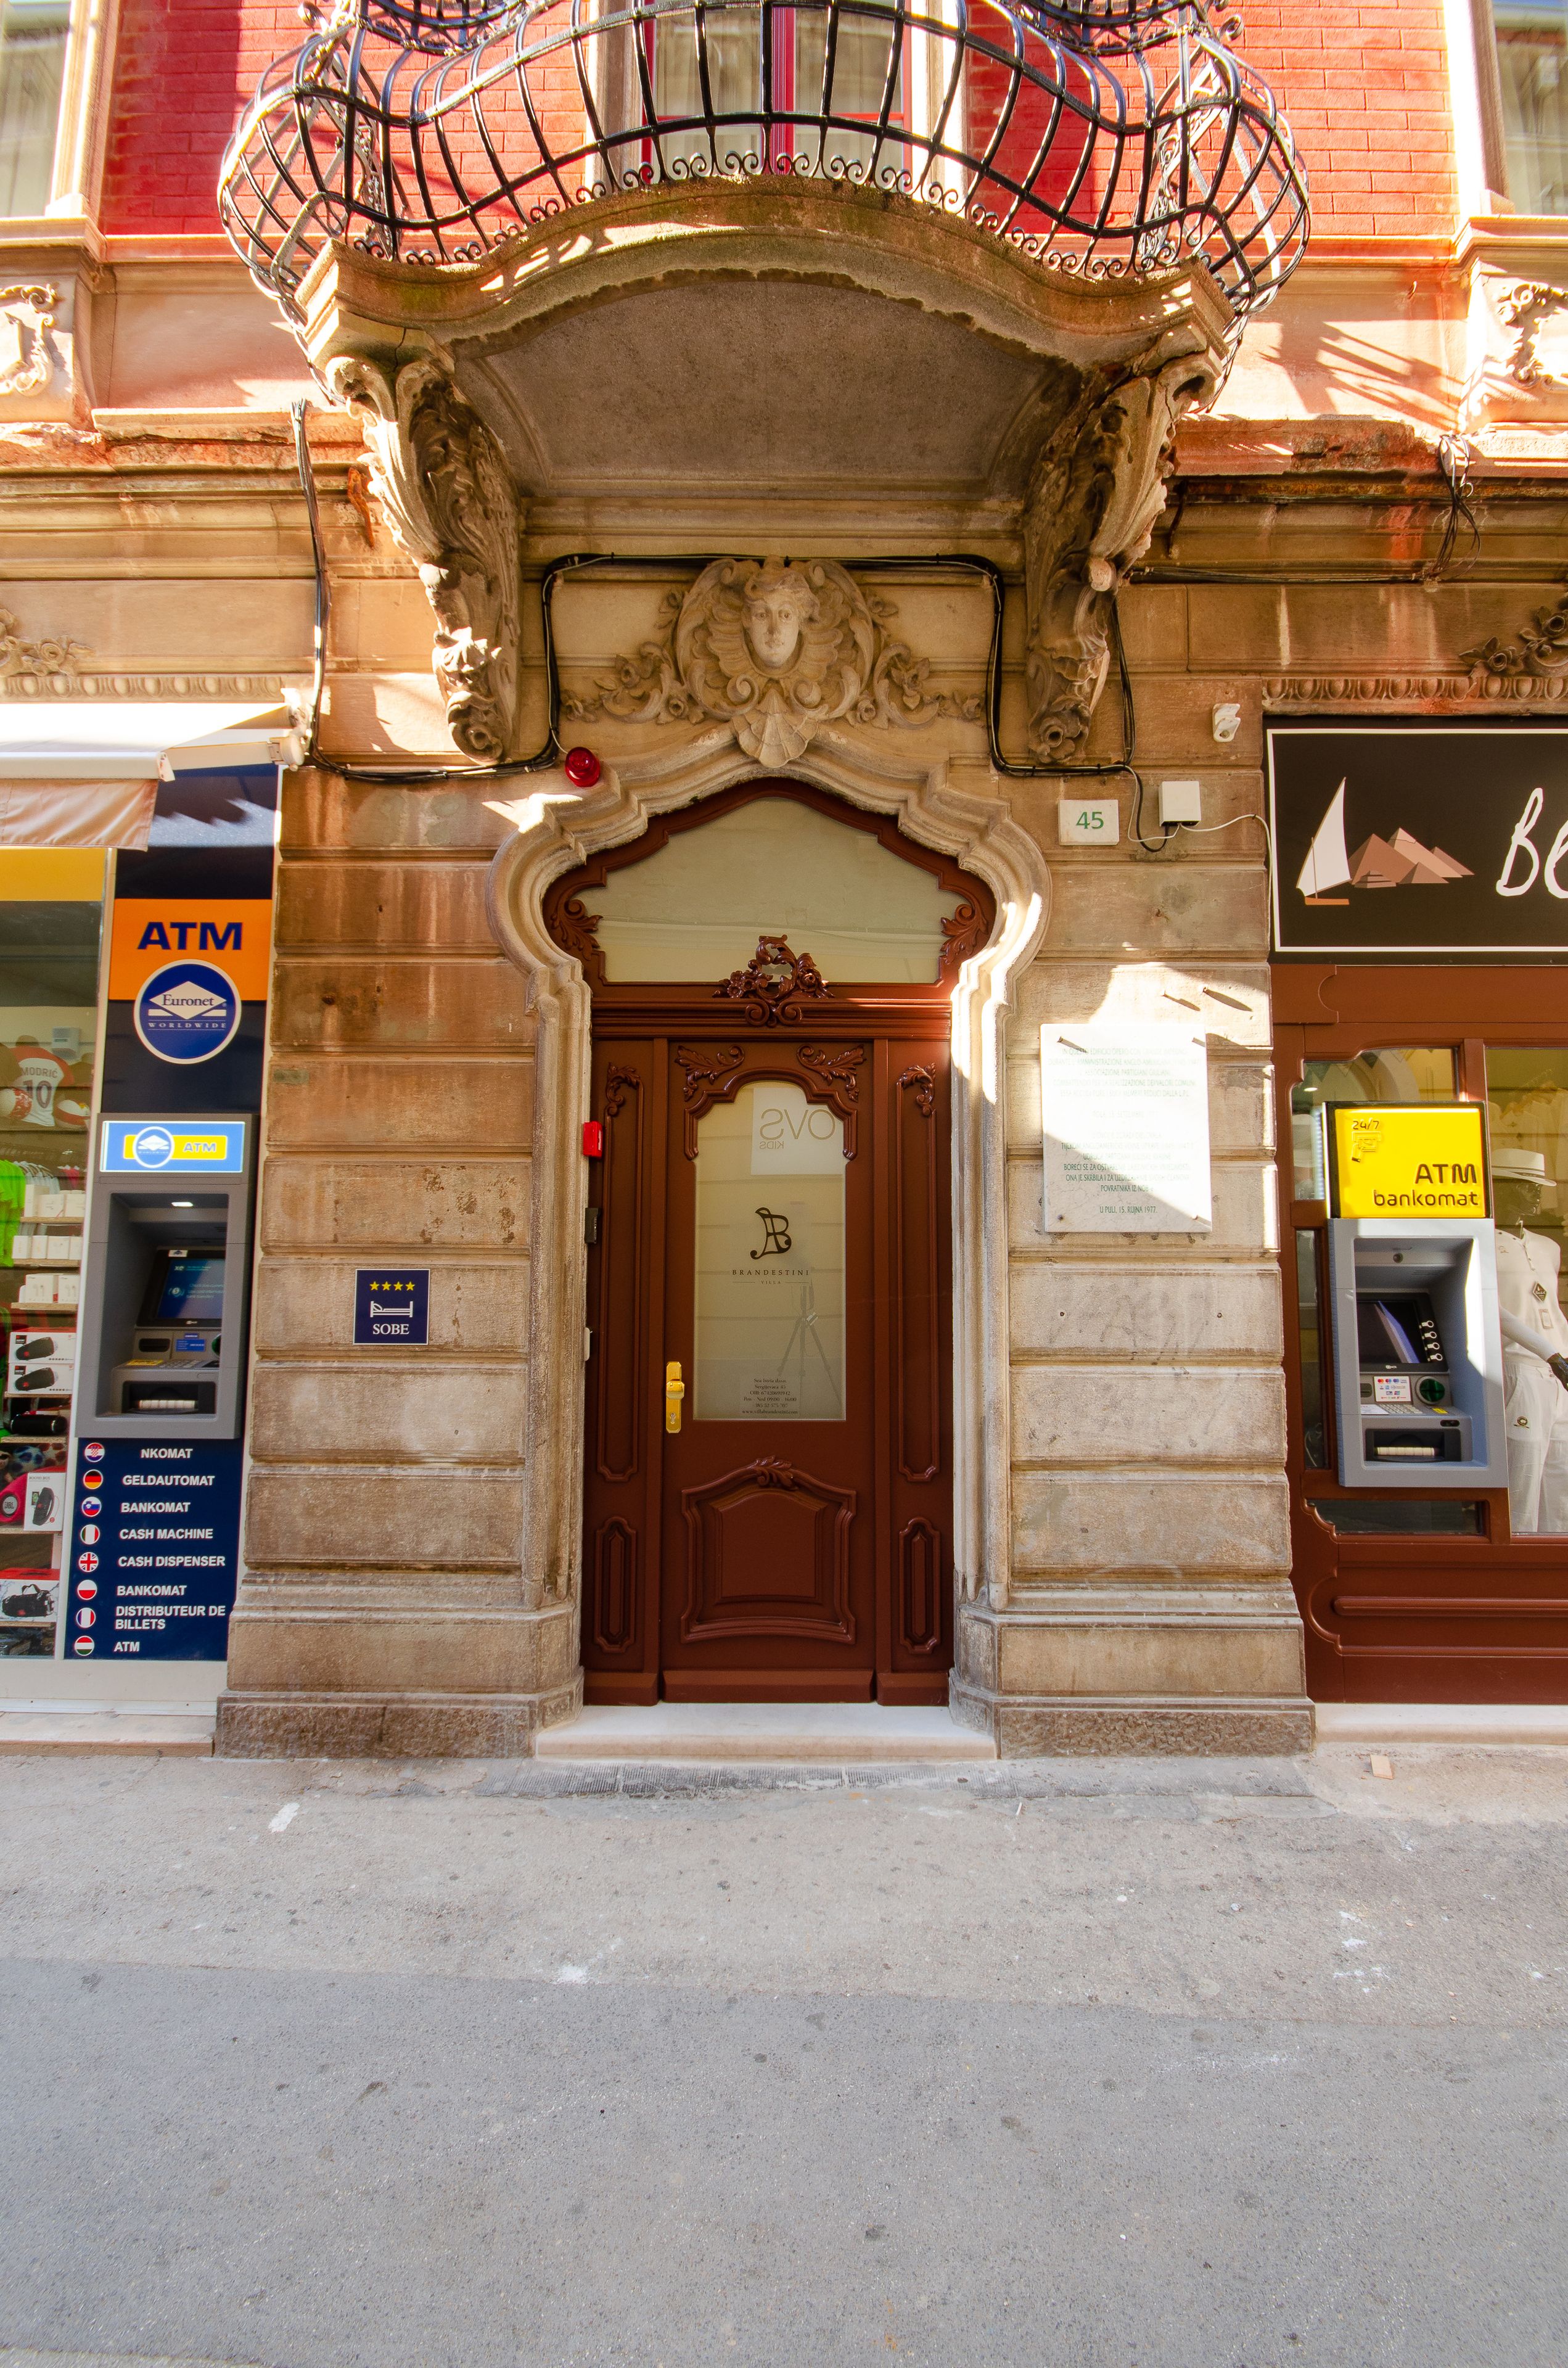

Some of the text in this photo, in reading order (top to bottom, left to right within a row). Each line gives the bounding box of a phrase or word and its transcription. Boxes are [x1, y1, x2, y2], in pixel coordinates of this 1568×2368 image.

[1075, 811, 1104, 830] 45
[137, 921, 243, 950] ATM
[162, 994, 215, 1006] Euronet
[23, 1080, 52, 1109] 10
[1352, 1120, 1379, 1130] 24/7
[183, 1142, 216, 1153] ATM
[1078, 1174, 1083, 1183] JE
[1415, 1163, 1477, 1185] ATM
[1373, 1190, 1479, 1207] bankomat
[1104, 1206, 1117, 1214] PULI,
[1127, 1206, 1143, 1215] RUJNA
[372, 1323, 410, 1335] SOBE
[141, 1448, 193, 1459] NKOMAT
[122, 1475, 215, 1486] GELDAUTOMAT
[121, 1502, 191, 1513] BANKOMAT
[120, 1528, 213, 1539] CASH MACHINE
[118, 1556, 226, 1567] CASH DISPENSER
[117, 1585, 187, 1596] BANKOMAT
[115, 1605, 226, 1616] DISTRIBUTEUR DE
[115, 1619, 166, 1630] BILLETS
[113, 1641, 140, 1652] ATM
